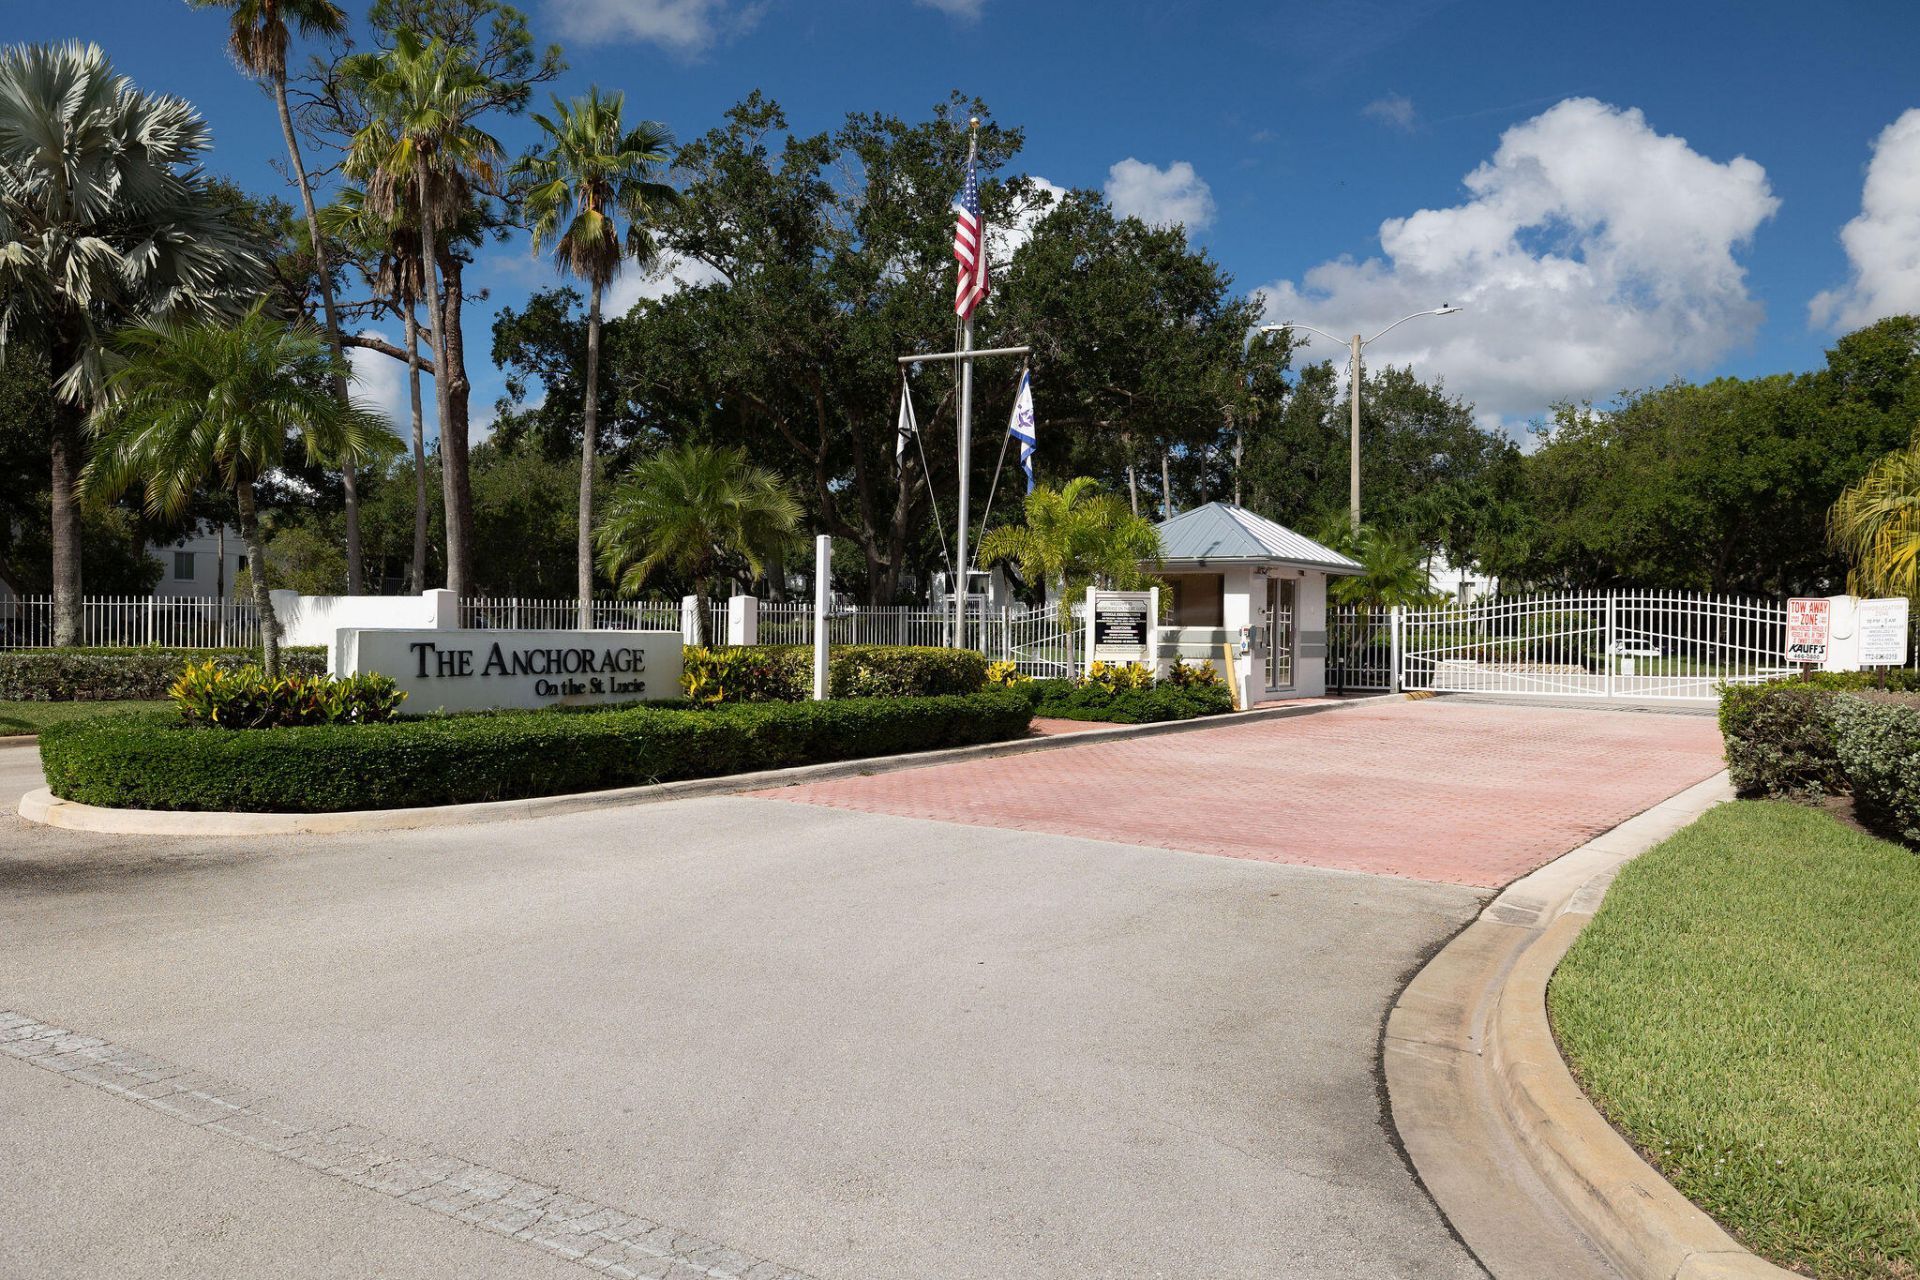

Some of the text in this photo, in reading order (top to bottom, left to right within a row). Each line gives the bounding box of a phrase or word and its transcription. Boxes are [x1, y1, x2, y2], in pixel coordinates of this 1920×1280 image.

[1791, 602, 1828, 613] TOW AWAY
[1801, 614, 1818, 625] ZONE
[1789, 644, 1826, 654] KAUFF'S
[410, 642, 645, 678] THE ANCHORAGE
[535, 679, 558, 696] On
[561, 678, 585, 694] the
[610, 676, 645, 693] Lucie
